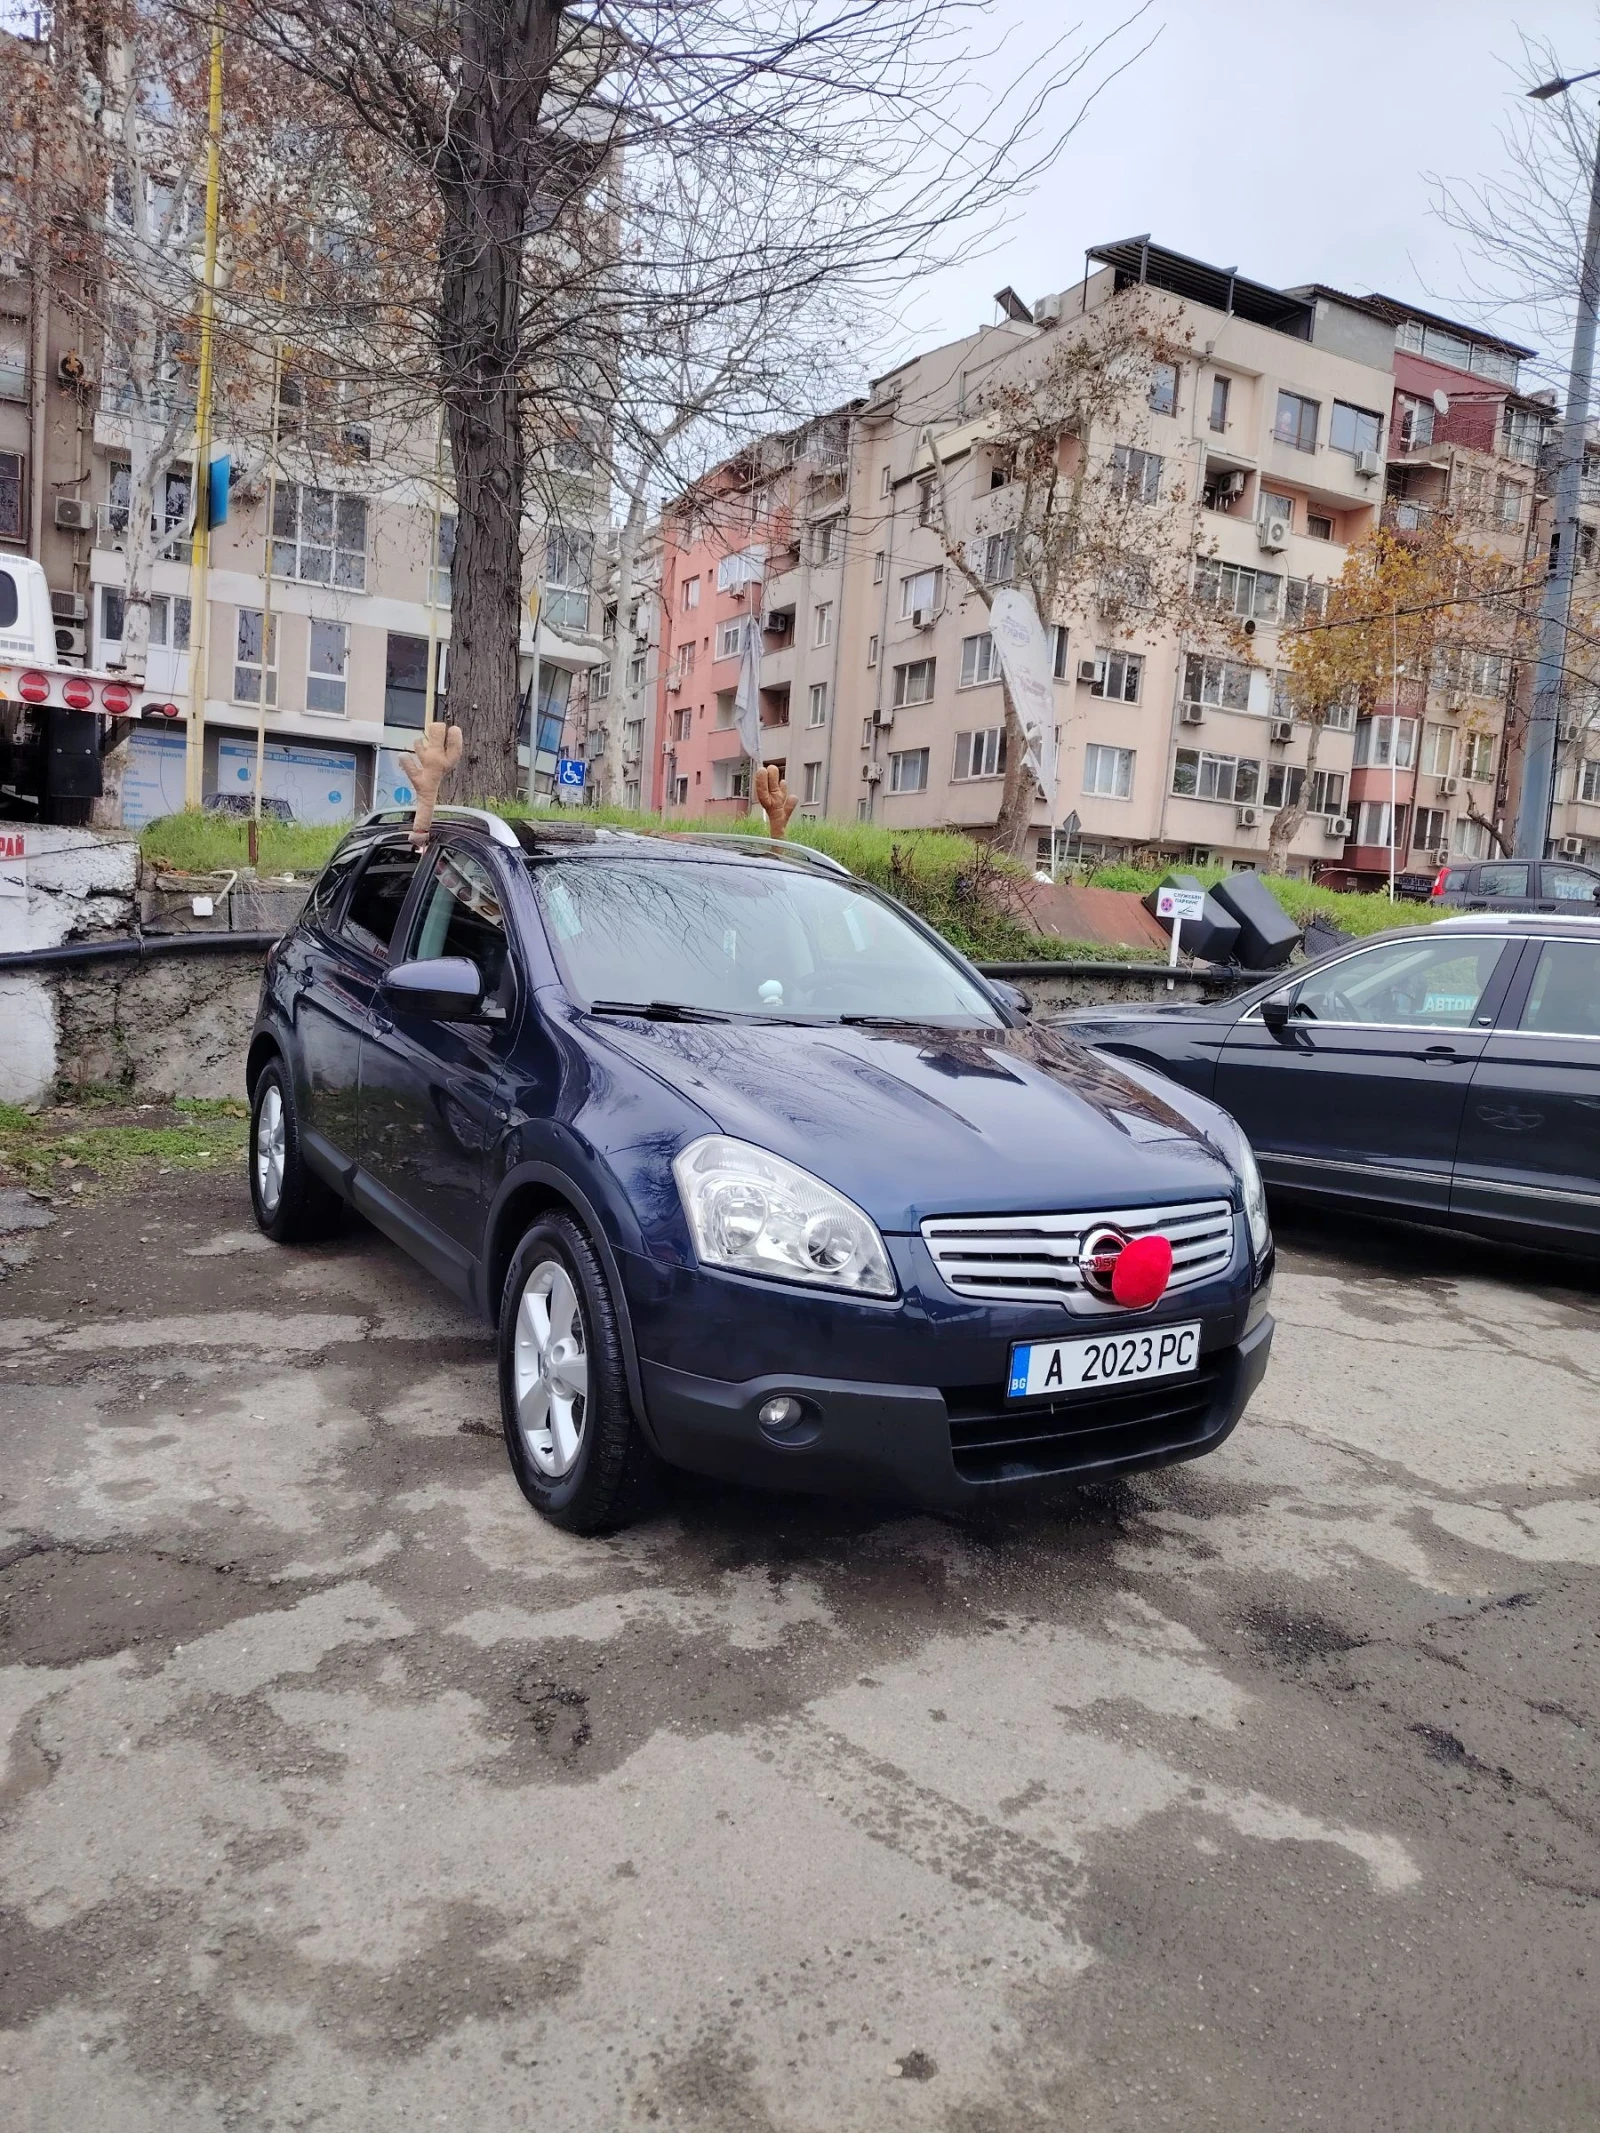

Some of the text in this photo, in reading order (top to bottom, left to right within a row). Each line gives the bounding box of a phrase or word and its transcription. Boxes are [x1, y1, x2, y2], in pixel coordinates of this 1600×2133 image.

[1174, 892, 1202, 900] СЛУЖЕБЕН
[1011, 1330, 1195, 1391] BG A 2023 PC
